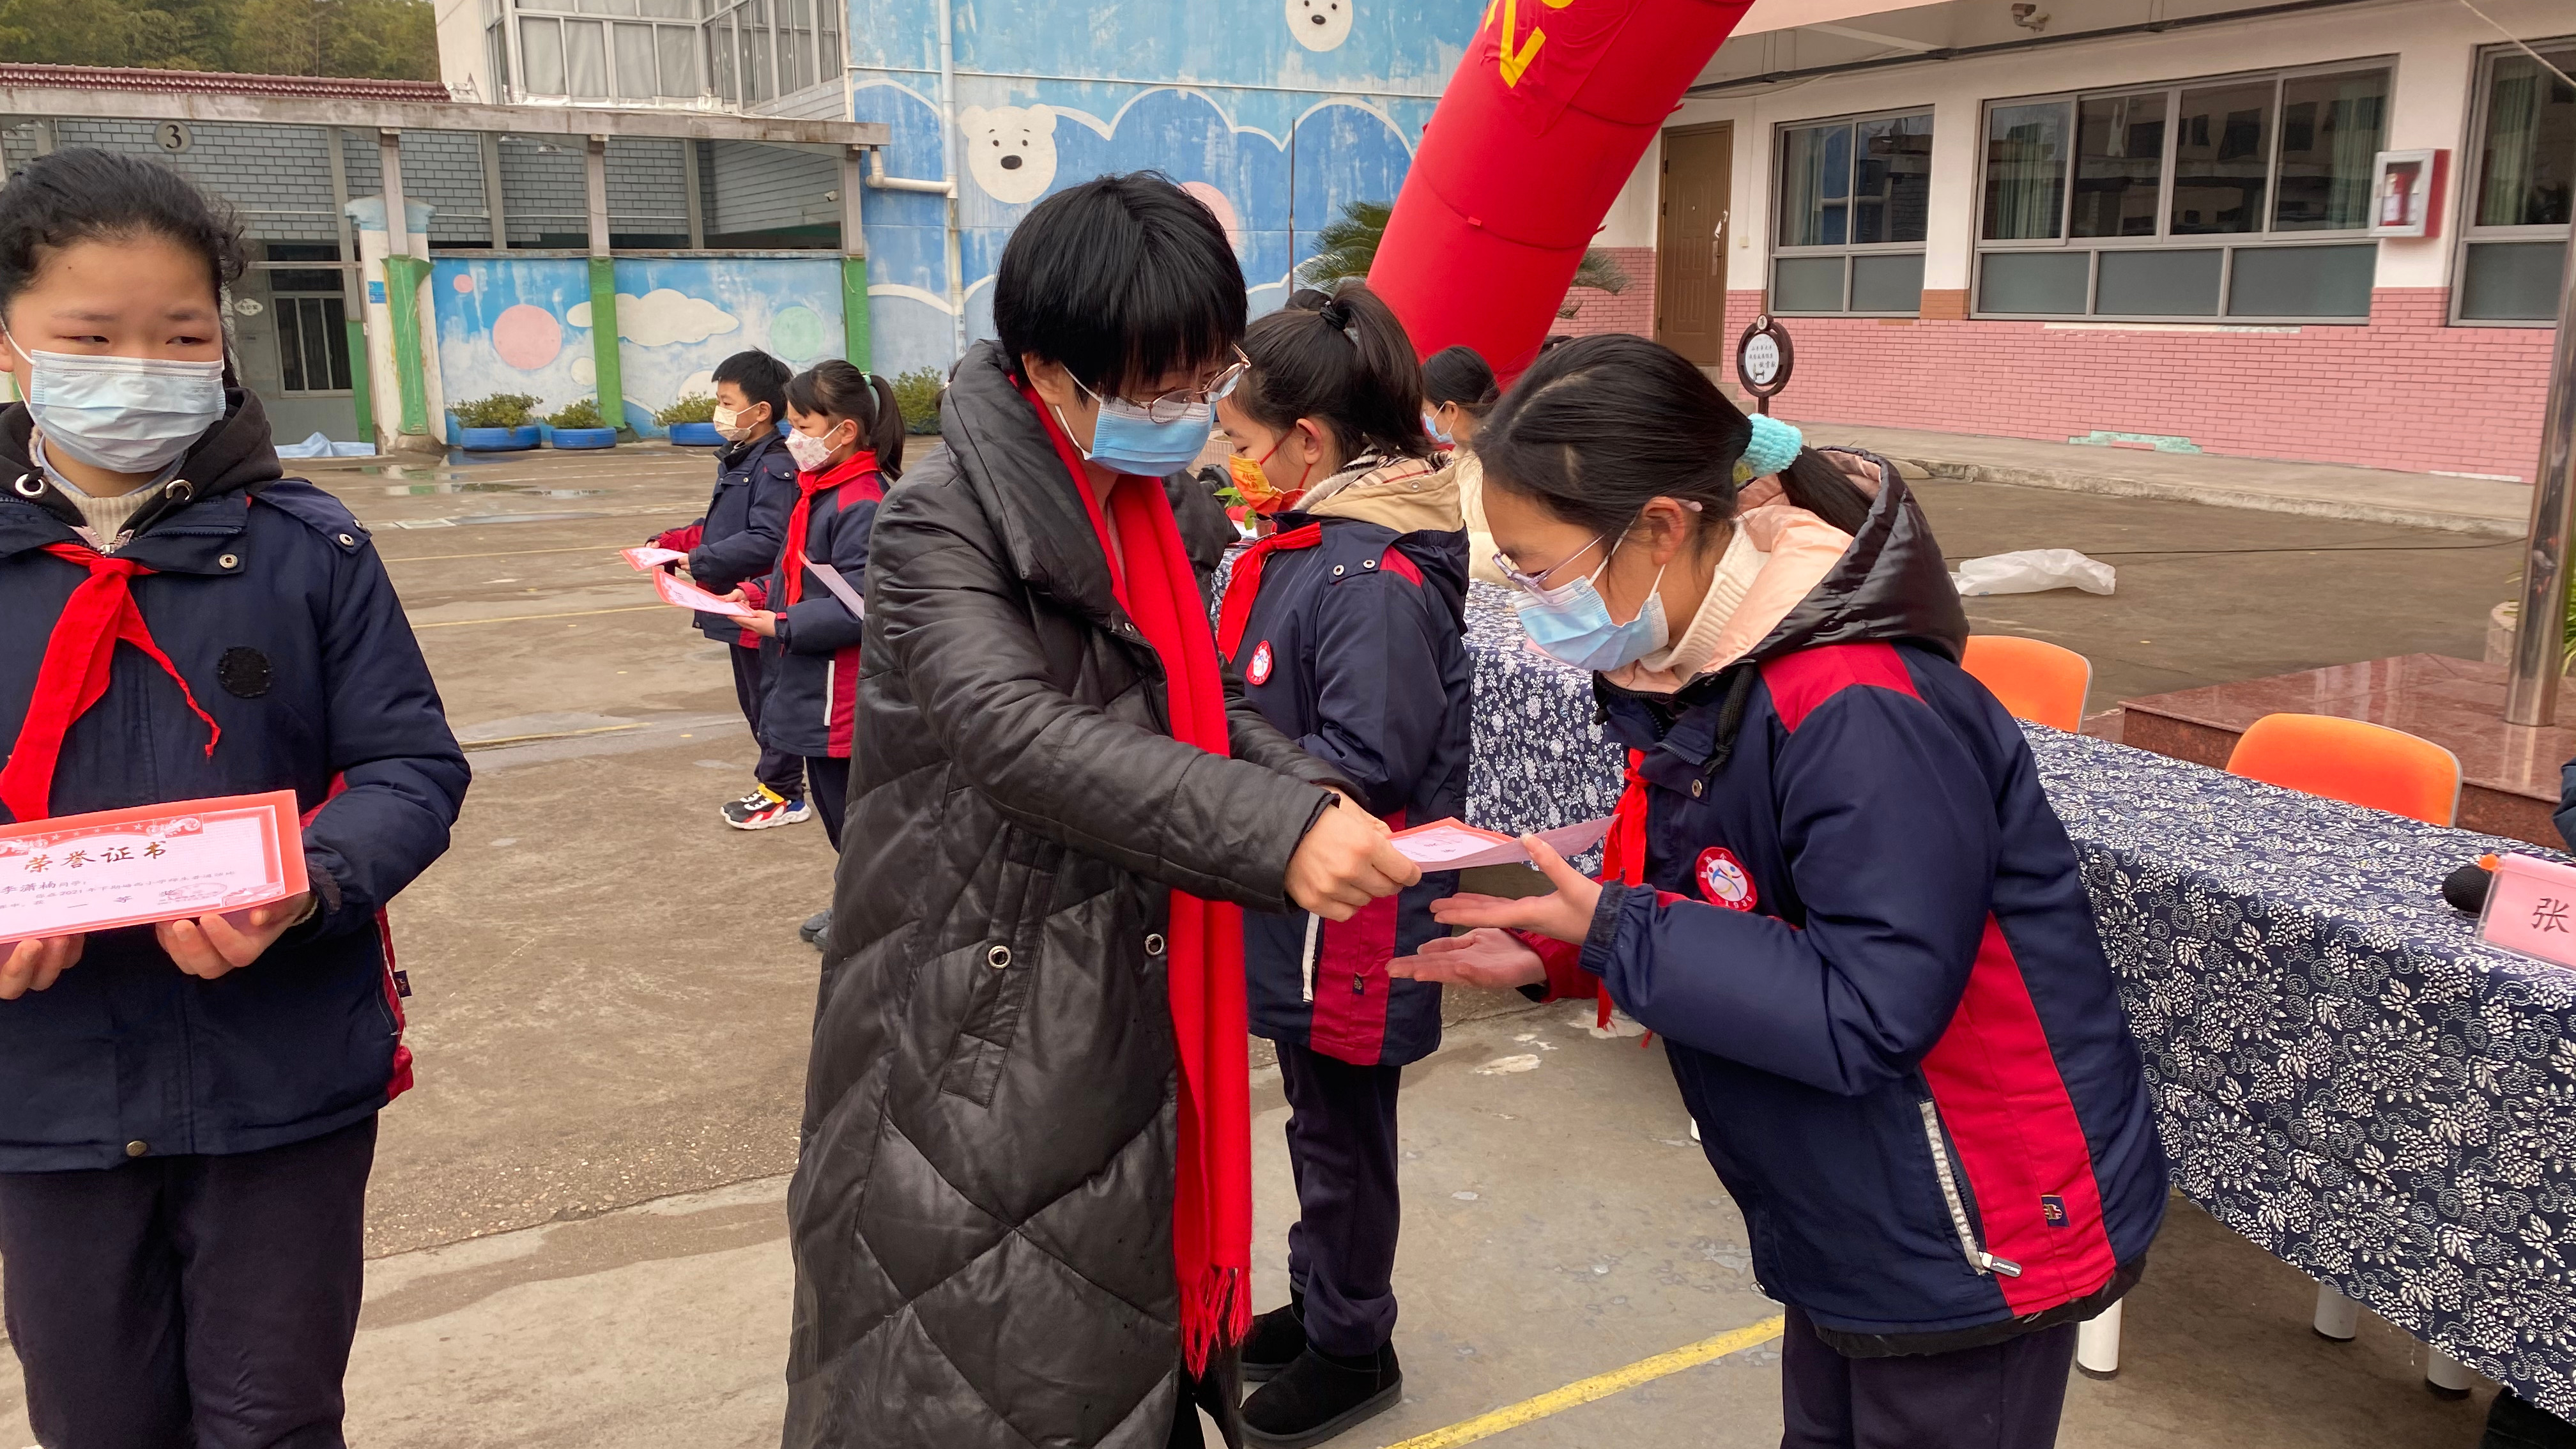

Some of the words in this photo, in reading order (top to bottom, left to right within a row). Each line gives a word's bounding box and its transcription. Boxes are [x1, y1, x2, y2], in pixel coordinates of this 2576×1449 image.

[165, 125, 182, 149] 3
[24, 840, 166, 873] 荣誉证书
[1724, 896, 1752, 908] 1930
[2531, 898, 2570, 933] 张
